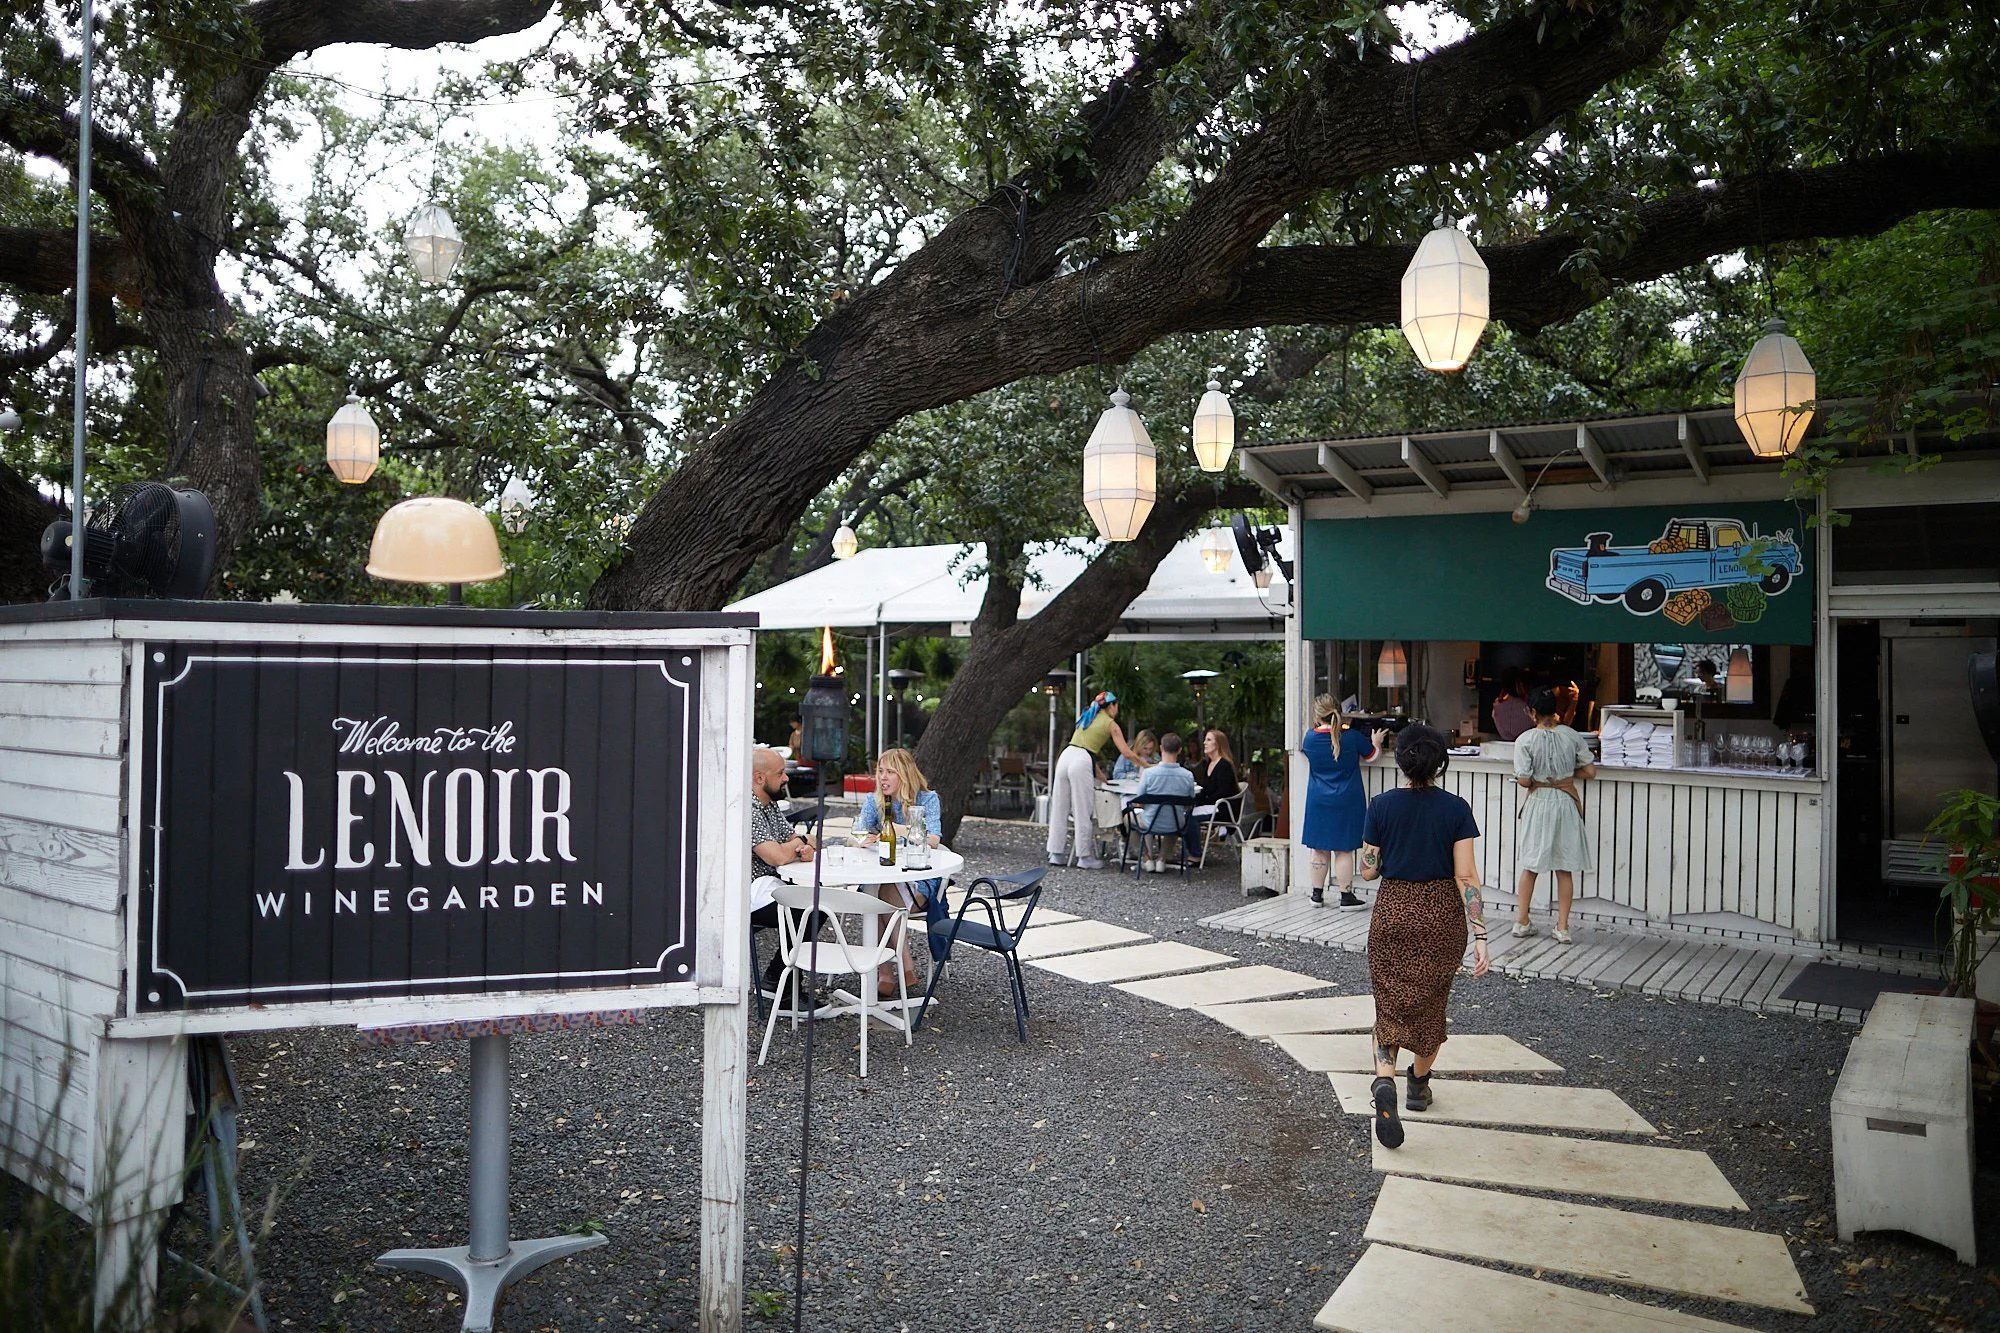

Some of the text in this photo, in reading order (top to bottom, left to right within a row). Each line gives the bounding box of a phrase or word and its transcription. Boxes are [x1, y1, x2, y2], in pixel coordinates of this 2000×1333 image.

[332, 716, 516, 755] Welcome to the
[283, 768, 577, 869] LENOIR
[257, 881, 602, 917] WINEGARDEN
